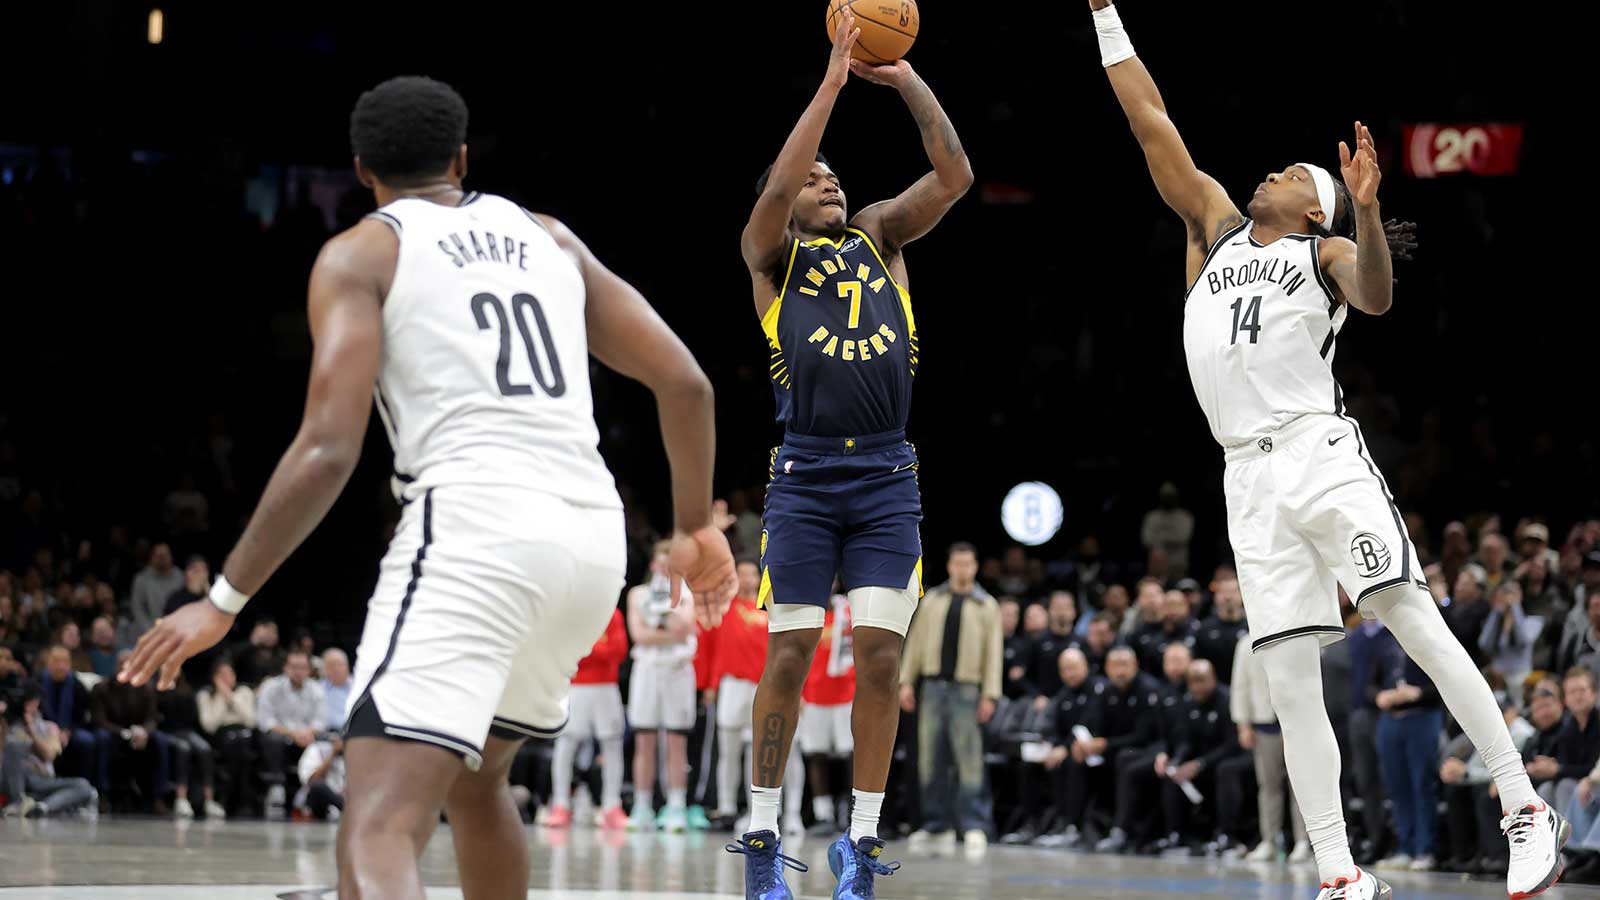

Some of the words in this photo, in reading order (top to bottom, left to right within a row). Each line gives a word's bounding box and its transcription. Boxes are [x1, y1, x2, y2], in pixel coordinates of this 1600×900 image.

[437, 230, 529, 271] SHARPE
[799, 253, 887, 297] INDINA
[1207, 257, 1306, 297] BROOKLYN
[837, 281, 862, 329] 7
[1230, 295, 1263, 346] 14
[470, 292, 566, 398] 20
[807, 323, 897, 361] PACERS
[1358, 540, 1380, 572] B
